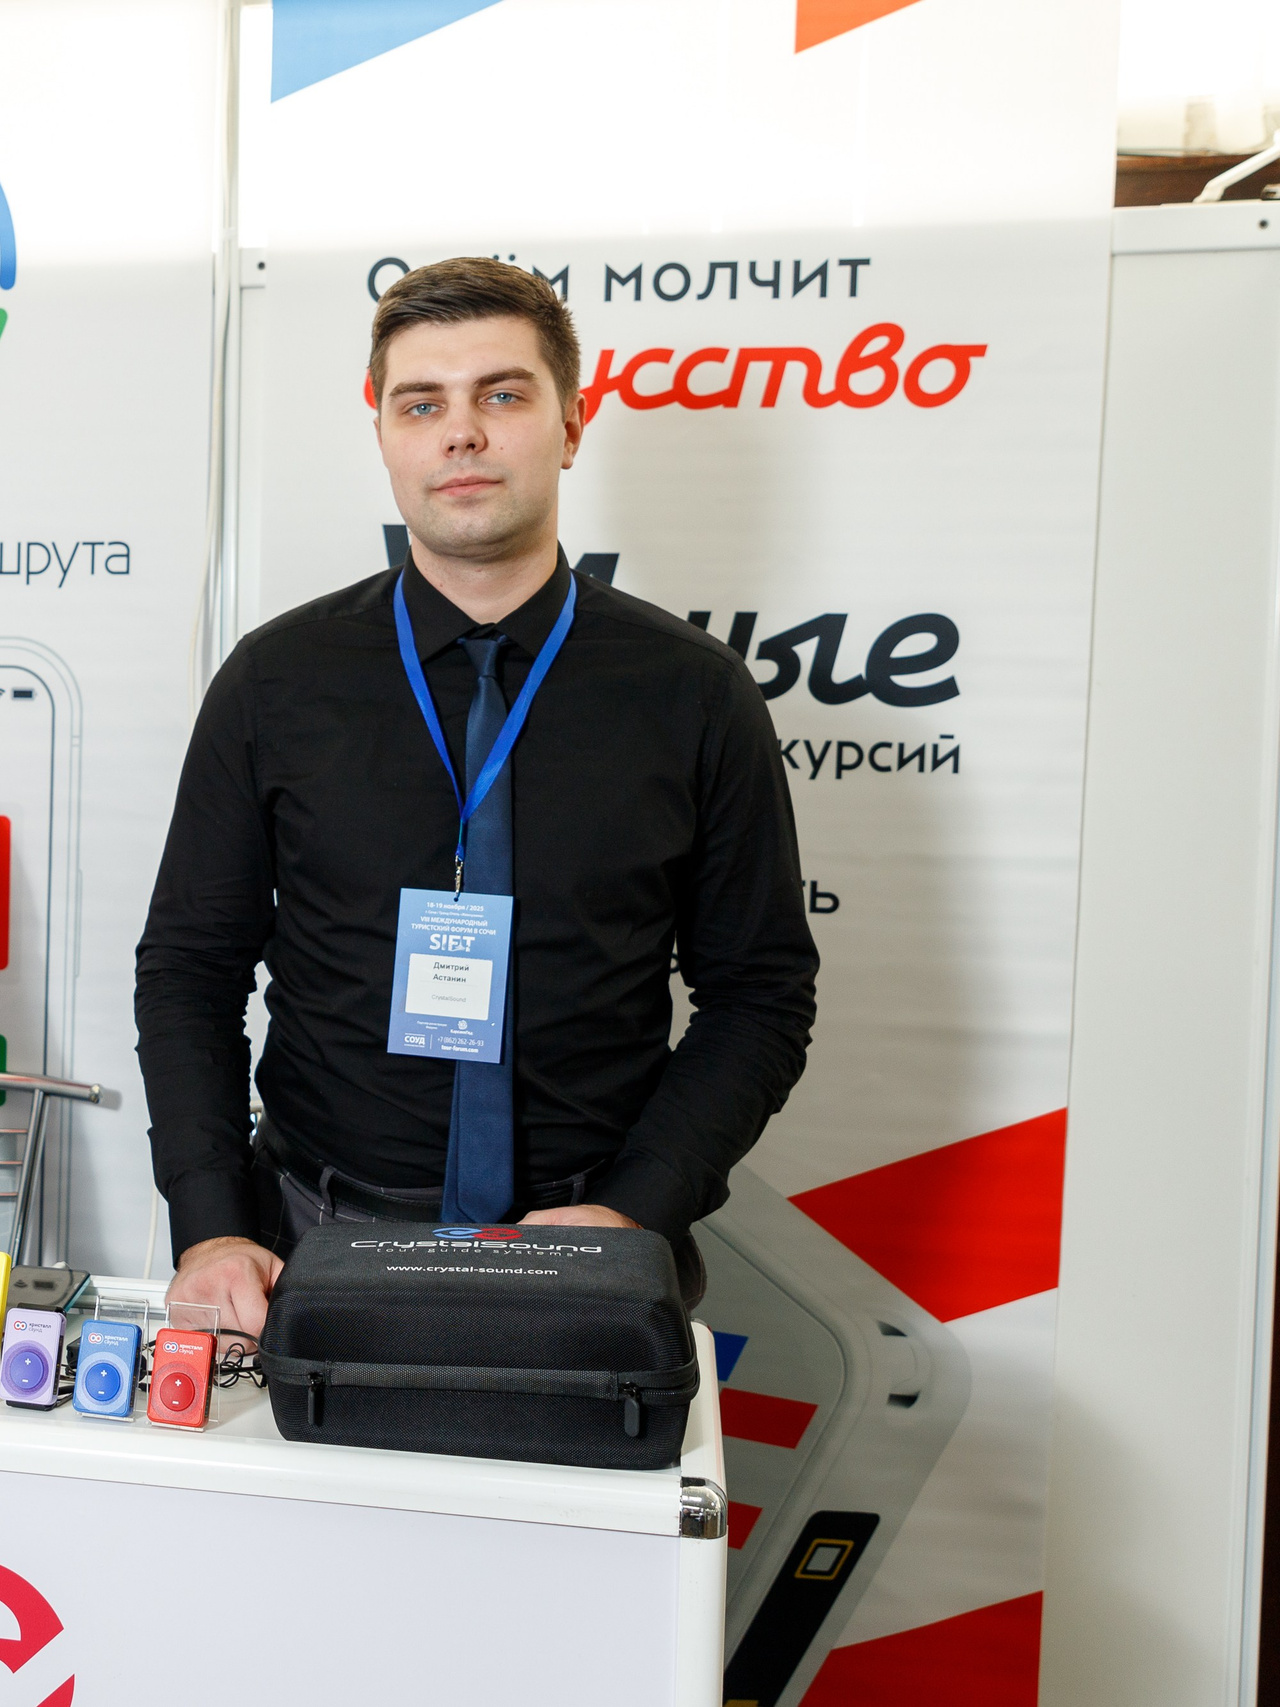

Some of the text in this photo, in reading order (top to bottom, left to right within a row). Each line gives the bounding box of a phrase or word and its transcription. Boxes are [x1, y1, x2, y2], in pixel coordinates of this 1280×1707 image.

[604, 256, 871, 302] молчит
[433, 962, 469, 972] Дмитрий
[433, 974, 466, 983] Астанин
[404, 1035, 425, 1045] СОУД
[350, 1240, 602, 1253] CrystalSound
[493, 1249, 574, 1257] systems
[386, 1265, 558, 1275] www.crystal-sound.com
